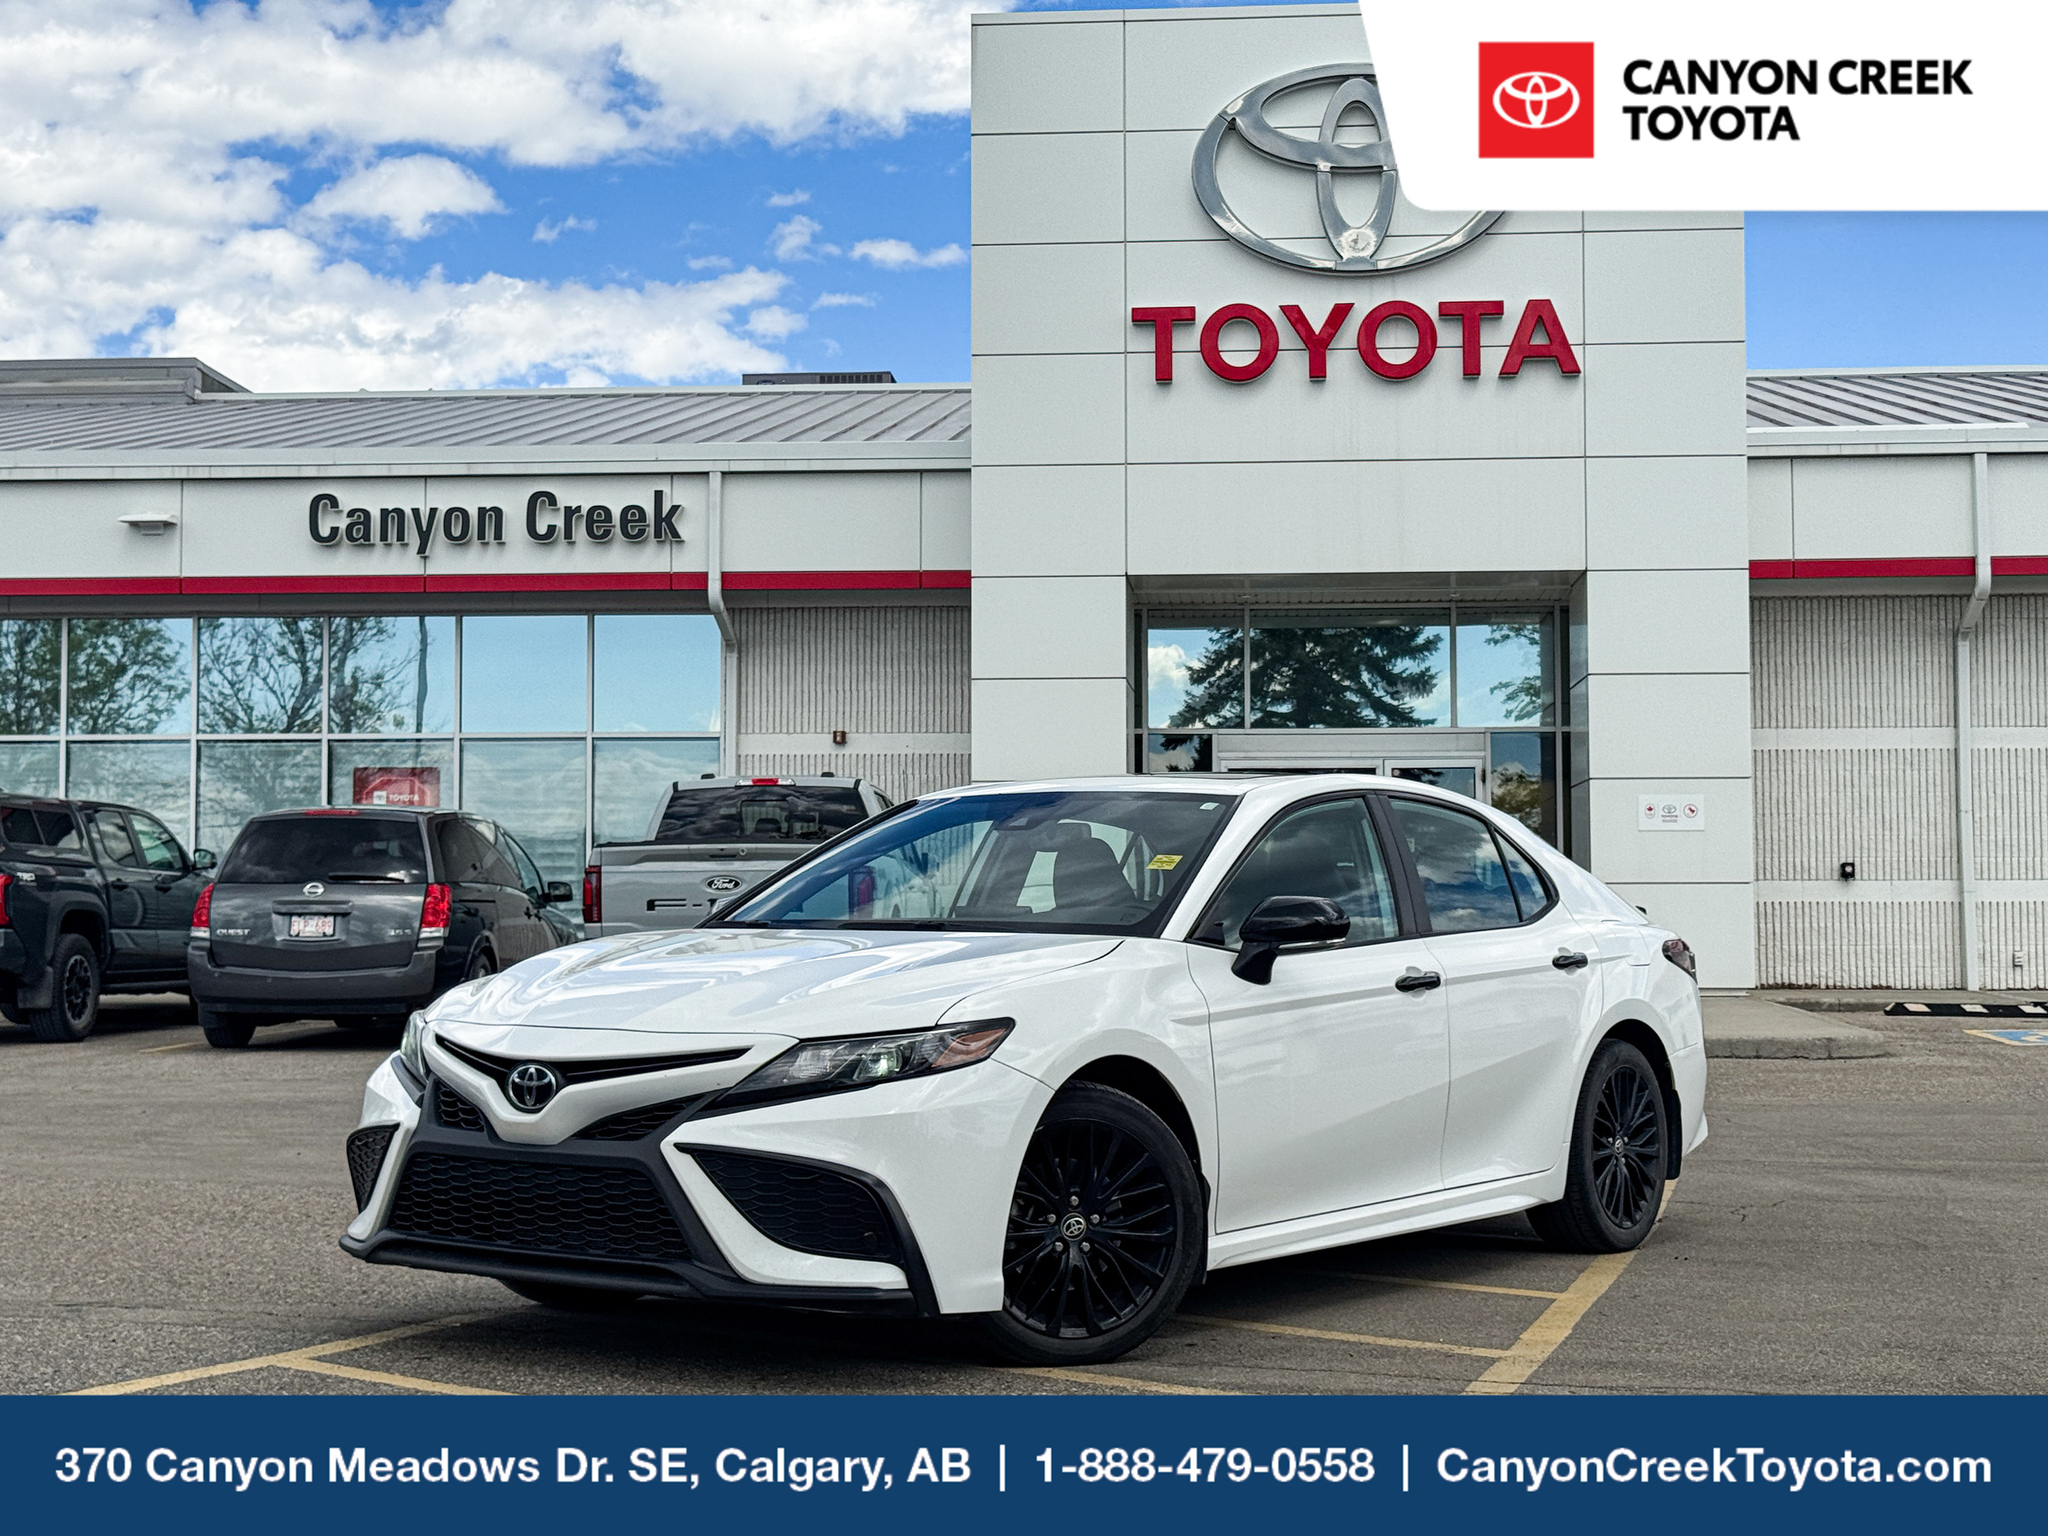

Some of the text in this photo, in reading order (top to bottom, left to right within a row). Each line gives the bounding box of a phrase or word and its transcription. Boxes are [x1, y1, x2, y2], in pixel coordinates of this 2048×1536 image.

[1131, 299, 1581, 383] TOYOTA
[308, 489, 685, 557] Canyon Creek
[389, 793, 420, 801] TOYOTA
[711, 878, 736, 889] Ford
